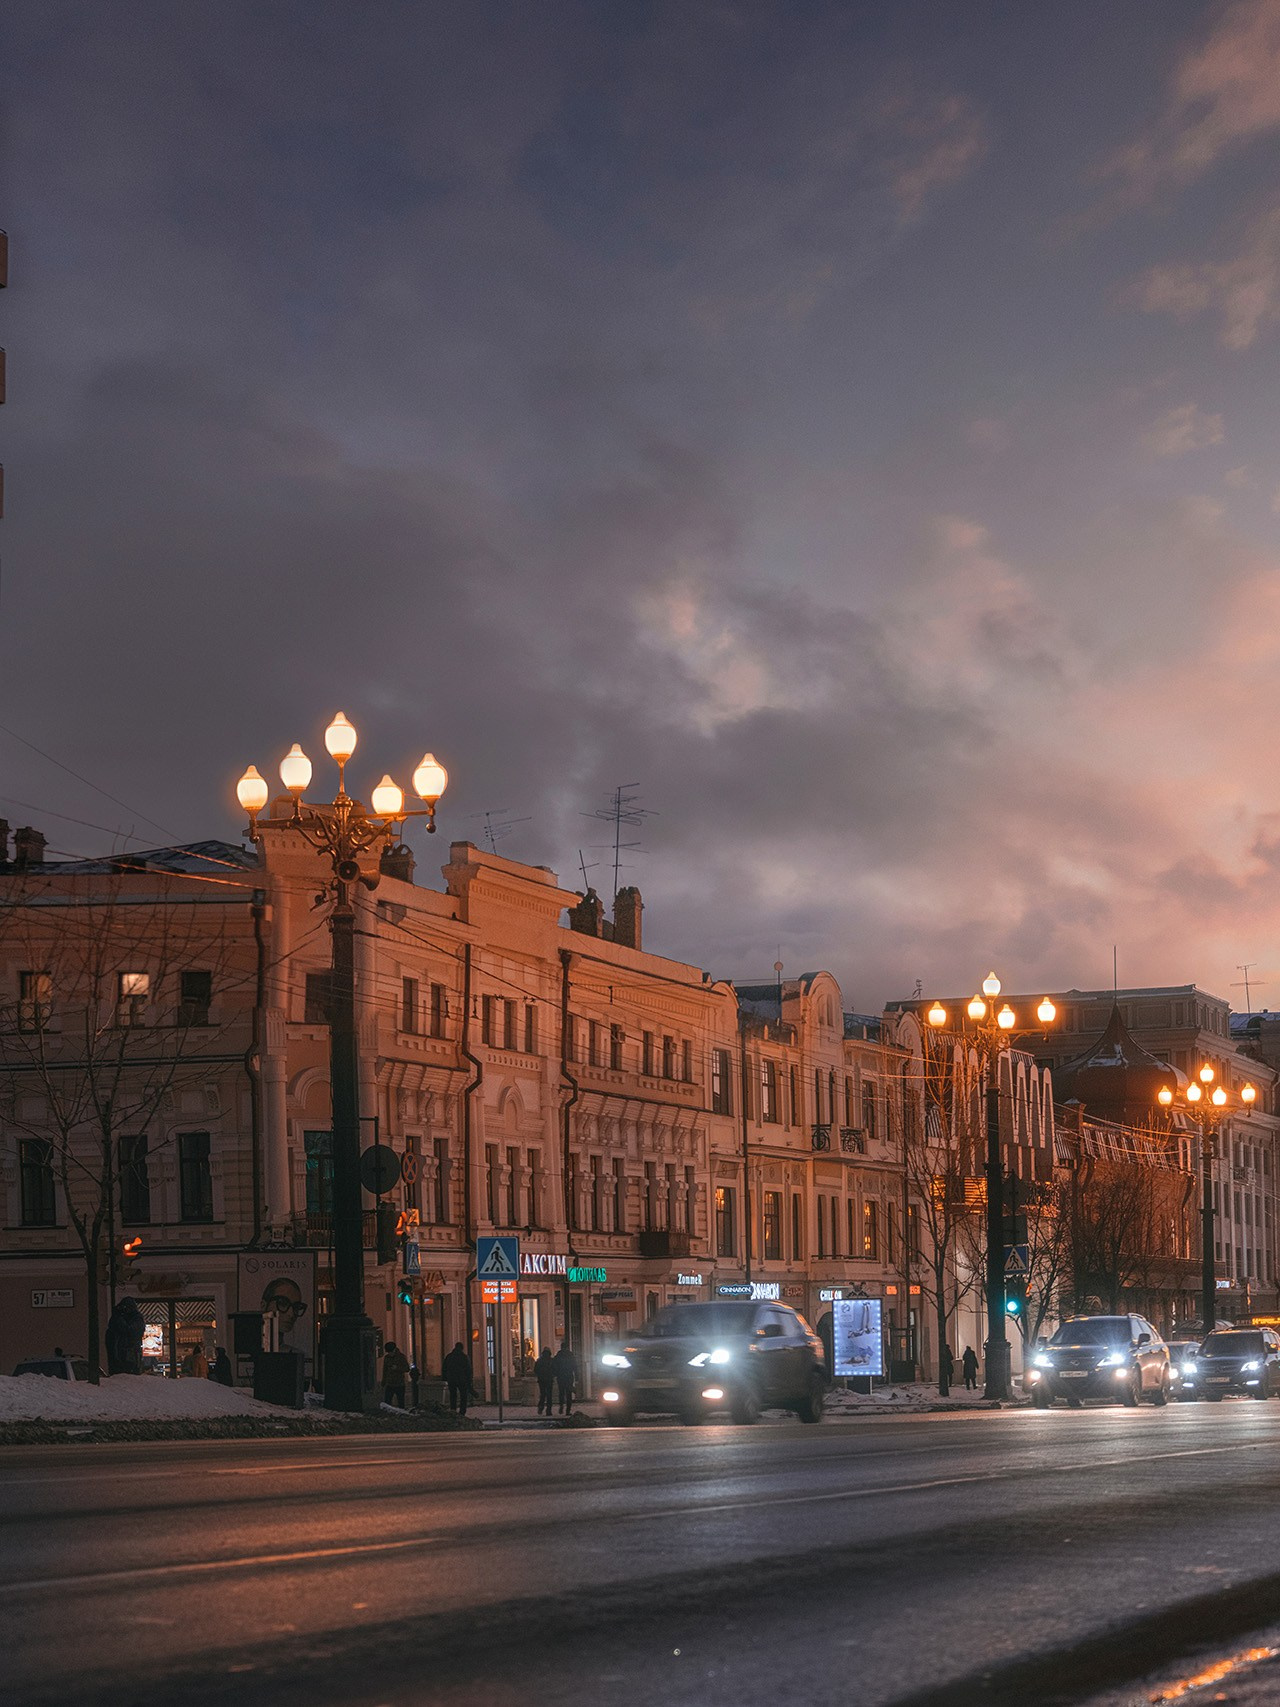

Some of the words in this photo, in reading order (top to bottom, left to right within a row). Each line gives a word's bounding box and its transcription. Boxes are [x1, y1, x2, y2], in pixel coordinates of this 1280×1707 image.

[262, 1260, 307, 1269] SOLARIS
[719, 1286, 752, 1294] CINNABON
[33, 1293, 45, 1305] 57
